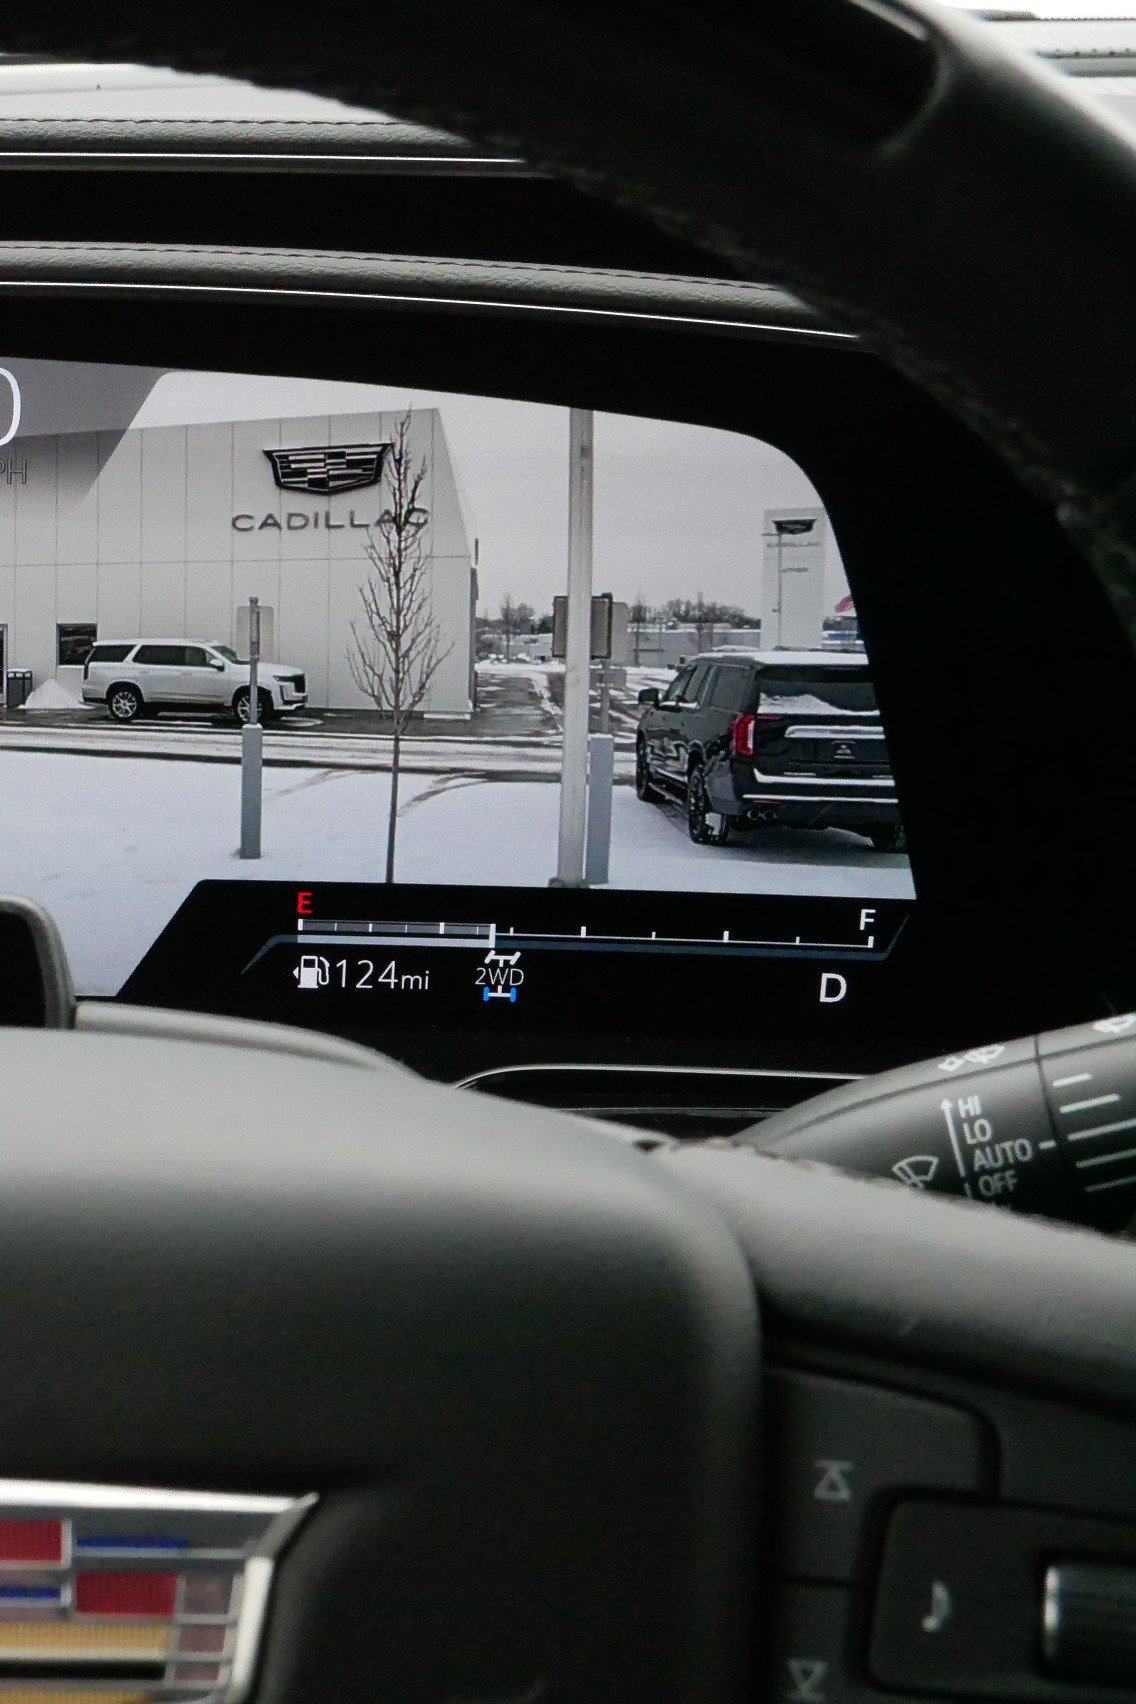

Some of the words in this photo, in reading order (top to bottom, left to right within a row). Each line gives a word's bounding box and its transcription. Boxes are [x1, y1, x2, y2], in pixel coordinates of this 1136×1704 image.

[231, 507, 430, 532] CADILLAC
[297, 891, 313, 914] E
[859, 908, 877, 931] F
[474, 967, 525, 986] 2WD
[819, 972, 847, 1003] D
[957, 1094, 983, 1118] HI
[962, 1118, 992, 1145] LO
[972, 1138, 1033, 1172] AUTO
[978, 1169, 1019, 1197] OFF
